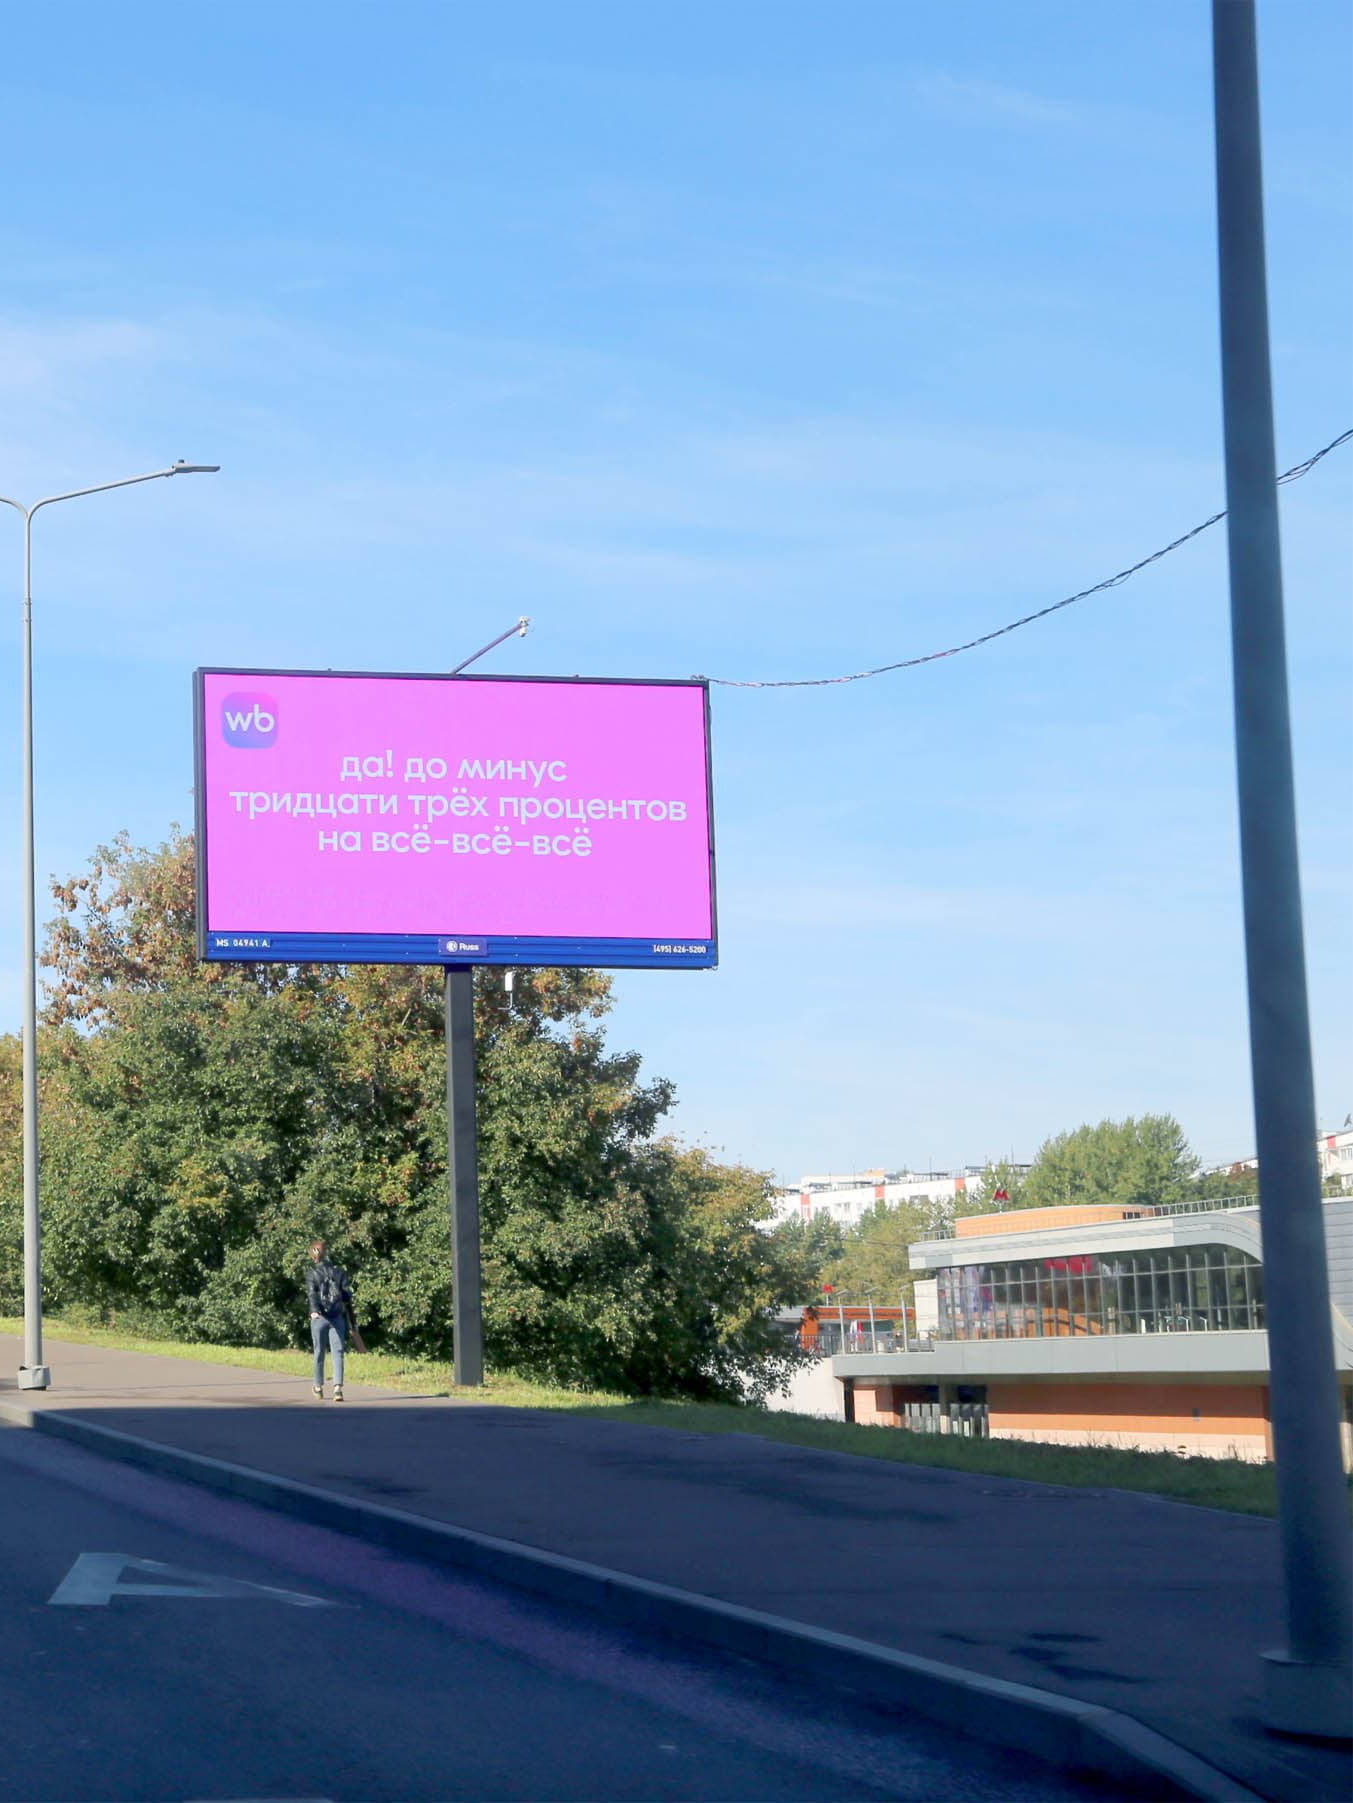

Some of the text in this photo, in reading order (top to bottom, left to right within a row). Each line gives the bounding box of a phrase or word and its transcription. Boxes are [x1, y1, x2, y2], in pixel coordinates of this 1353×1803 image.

[225, 703, 274, 732] wb
[339, 749, 568, 789] да! до минус
[229, 786, 688, 826] тридцати трёх процентов
[318, 823, 593, 857] на всё-всё-всё
